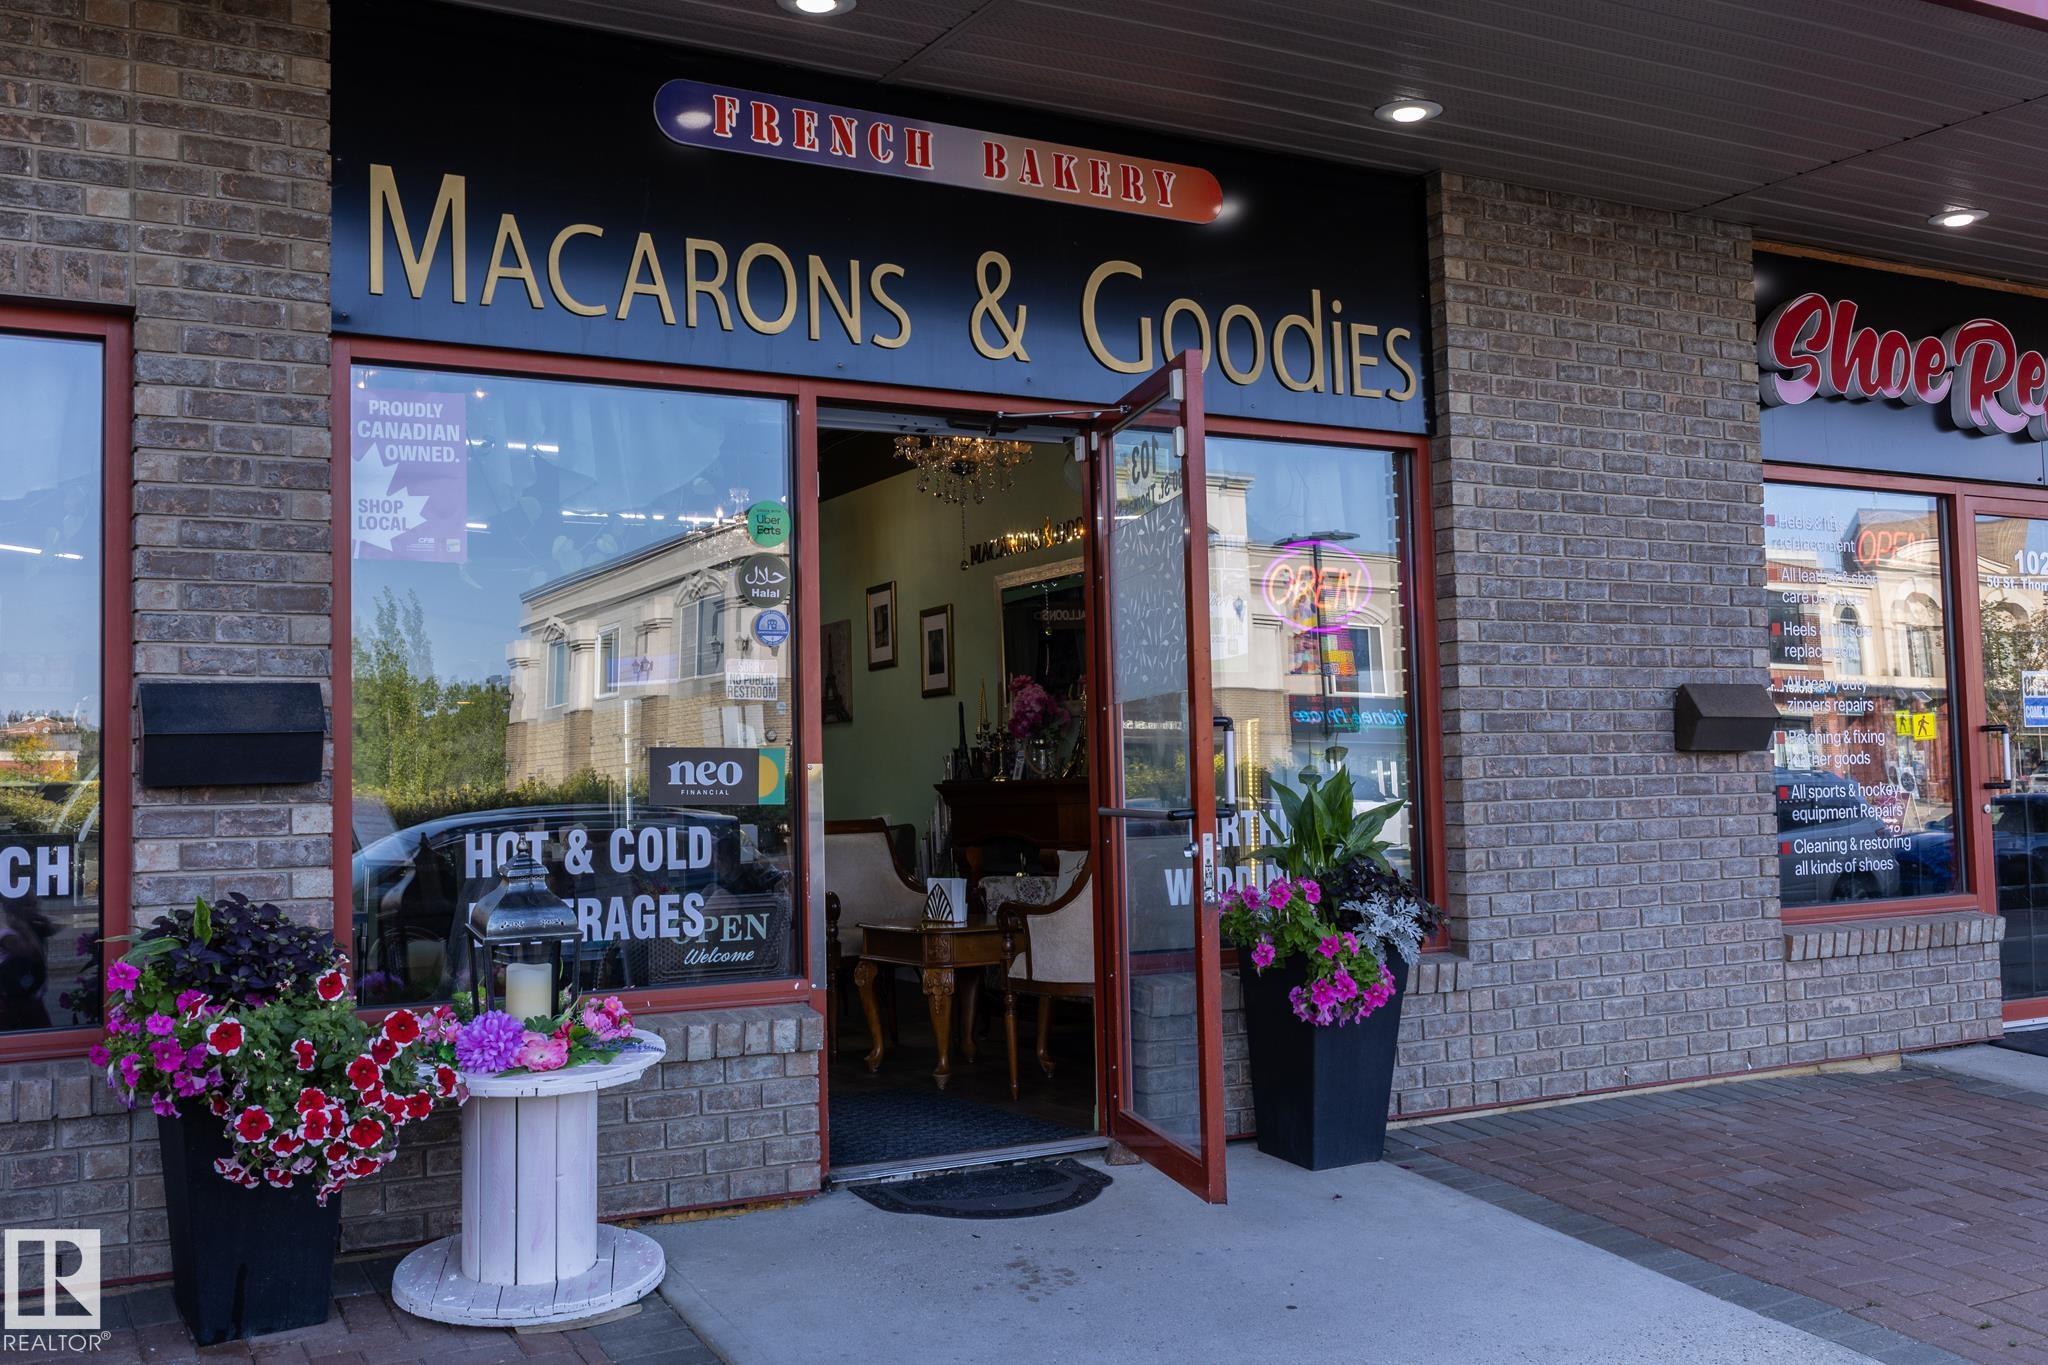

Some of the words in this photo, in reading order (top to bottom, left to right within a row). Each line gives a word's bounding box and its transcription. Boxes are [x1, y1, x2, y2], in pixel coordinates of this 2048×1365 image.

[712, 94, 936, 171] FRENCH
[982, 140, 1177, 208] BAKERY
[369, 163, 912, 350] MACARONS
[969, 250, 1031, 364] &
[1760, 292, 1954, 406] Shoe
[1948, 318, 2048, 438] Re
[368, 399, 444, 419] PROUDLY
[357, 419, 460, 442] CANADIAN
[385, 444, 460, 463] OWNED.
[358, 498, 405, 514] SHOP
[358, 516, 409, 531] LOCAL
[756, 513, 781, 525] Uber
[757, 525, 782, 535] Eats
[745, 565, 787, 585] حلال
[1781, 567, 1796, 582] All
[751, 588, 780, 598] Halal
[1268, 563, 1362, 610] OPEN
[1782, 592, 1809, 604] care
[1783, 620, 1816, 637] Heels
[736, 661, 766, 673] SORRY
[730, 673, 742, 685] NO
[744, 674, 775, 686] PUBLIC
[1787, 675, 1801, 688] All
[1803, 675, 1839, 692] heavy
[1842, 677, 1867, 693] duty
[727, 686, 777, 699] RESTROOM
[1787, 697, 1831, 713] zippers
[1833, 697, 1874, 713] repairs
[1788, 730, 1841, 746] Patching
[1843, 731, 1852, 743] &
[1853, 730, 1885, 746] fixing
[1834, 750, 1871, 768] goods
[667, 760, 743, 785] neo
[1791, 784, 1806, 800] All
[1808, 785, 1846, 801] sports
[1848, 783, 1857, 797] &
[1858, 781, 1900, 800] hockey
[1792, 805, 1858, 824] equipment
[1860, 803, 1904, 822] Repairs
[465, 831, 549, 879] HOT
[564, 829, 596, 875] &
[609, 826, 713, 874] COLD
[1793, 838, 1848, 856] Cleaning
[1849, 837, 1859, 851] &
[1859, 835, 1912, 852] restoring
[0, 846, 69, 897] CH
[1795, 860, 1809, 876] all
[1810, 859, 1843, 875] kinds
[1845, 857, 1857, 872] of
[1858, 857, 1894, 872] shoes
[684, 946, 755, 966] Welcome
